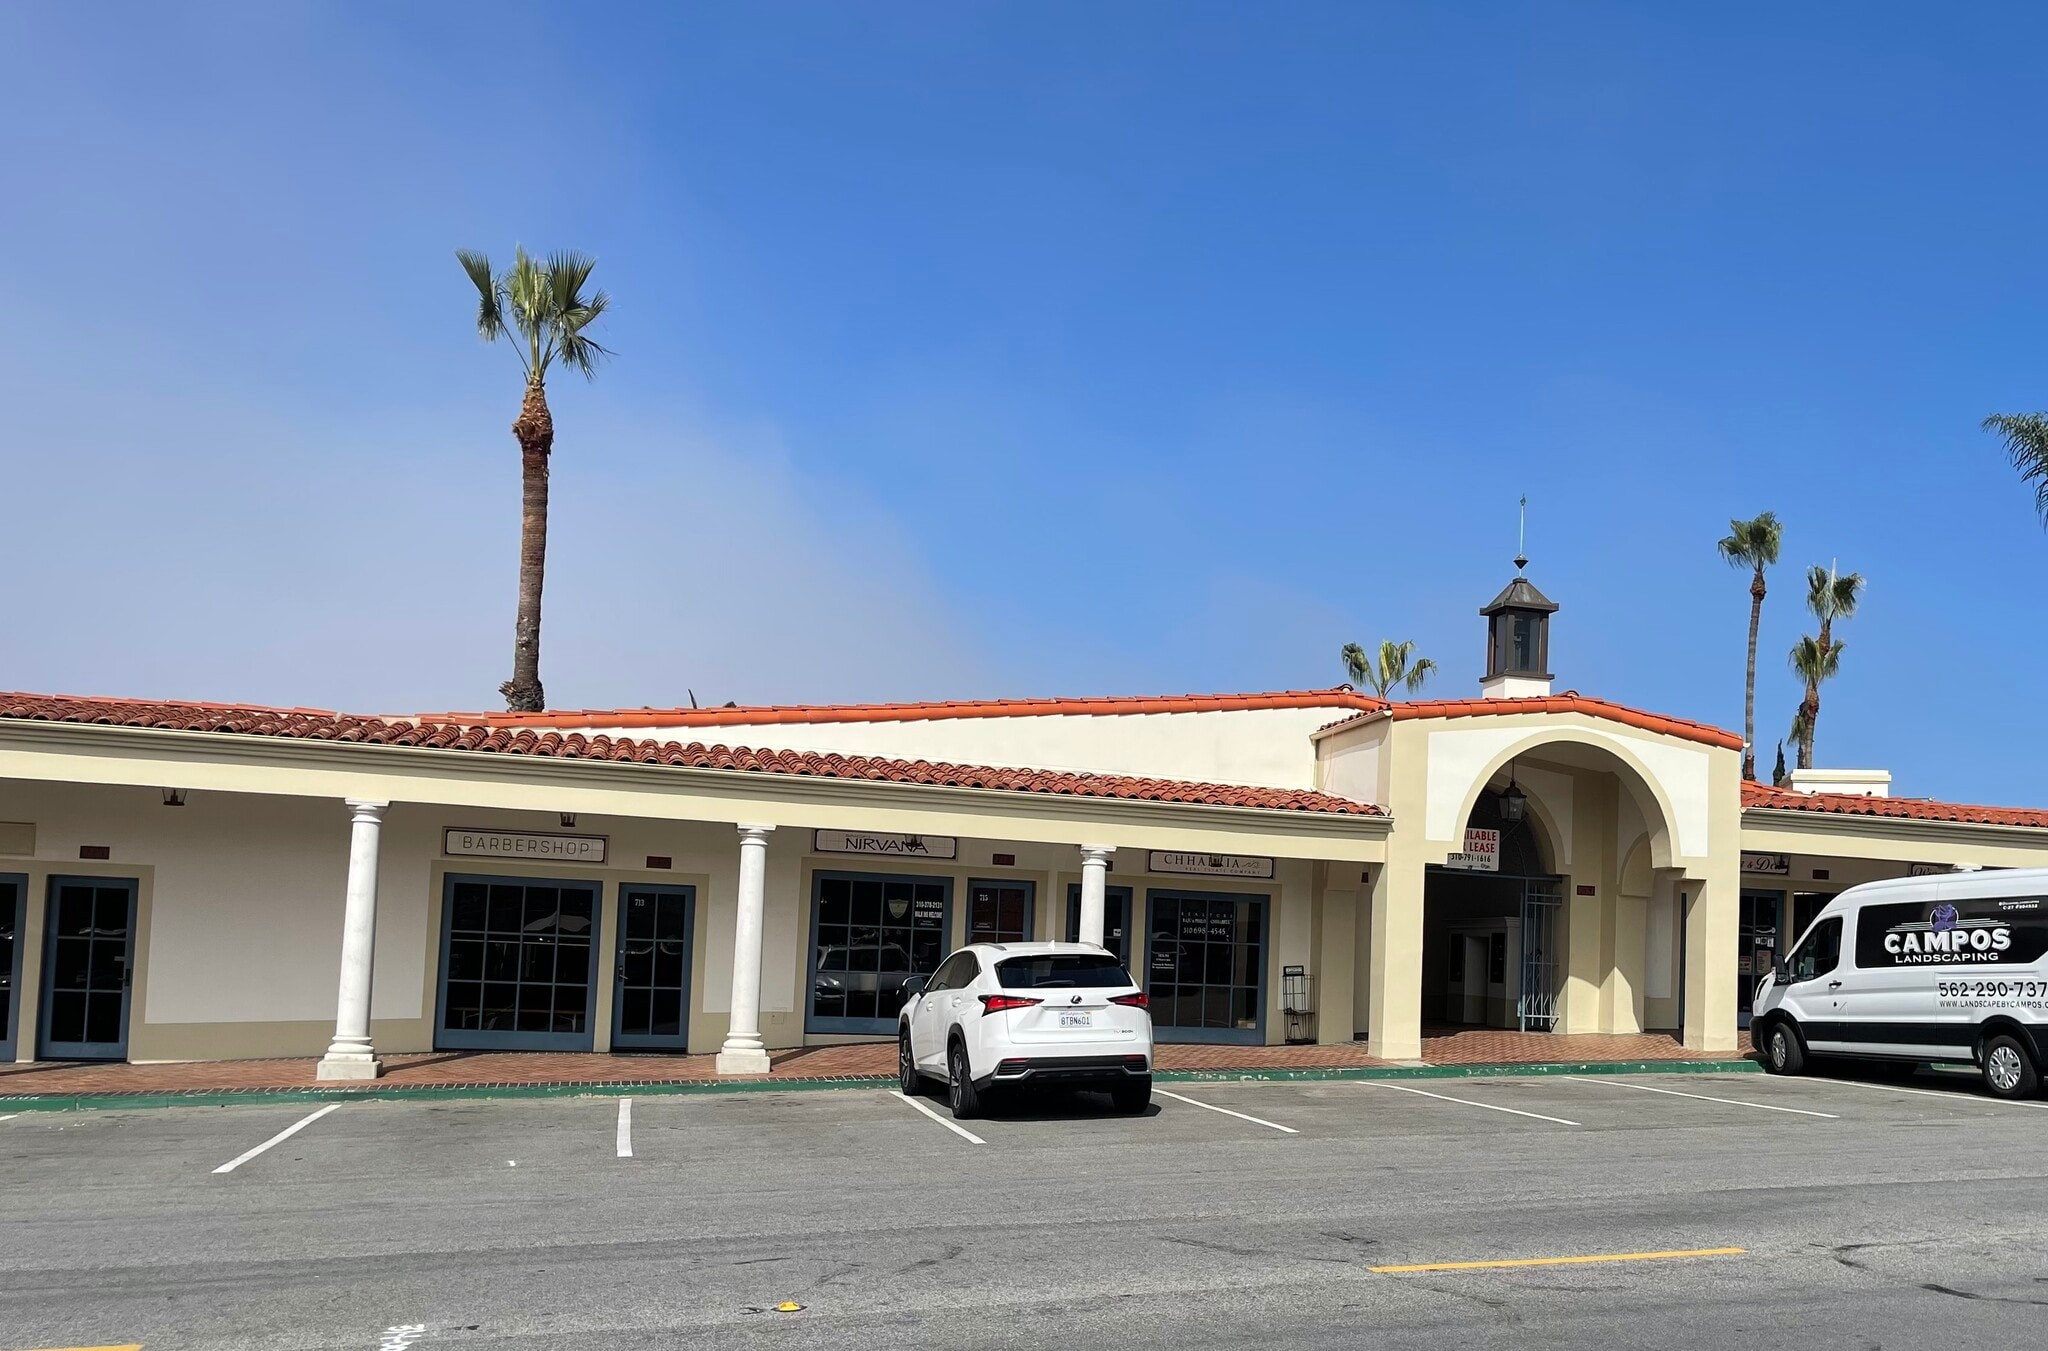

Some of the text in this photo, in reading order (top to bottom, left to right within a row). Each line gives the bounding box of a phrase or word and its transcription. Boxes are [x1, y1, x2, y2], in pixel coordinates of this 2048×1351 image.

[1464, 829, 1497, 841] ILABLE
[462, 835, 590, 855] BARBERSHOP
[1469, 842, 1495, 853] LEASE
[1164, 854, 1240, 869] CHHAIA
[1450, 853, 1491, 863] 310-791-1616
[634, 898, 645, 907] 713
[979, 894, 989, 902] 715
[1884, 928, 2012, 954] CAMPOS
[1895, 952, 1999, 964] LANDSCAPING
[1060, 1016, 1090, 1026] 8TBN601
